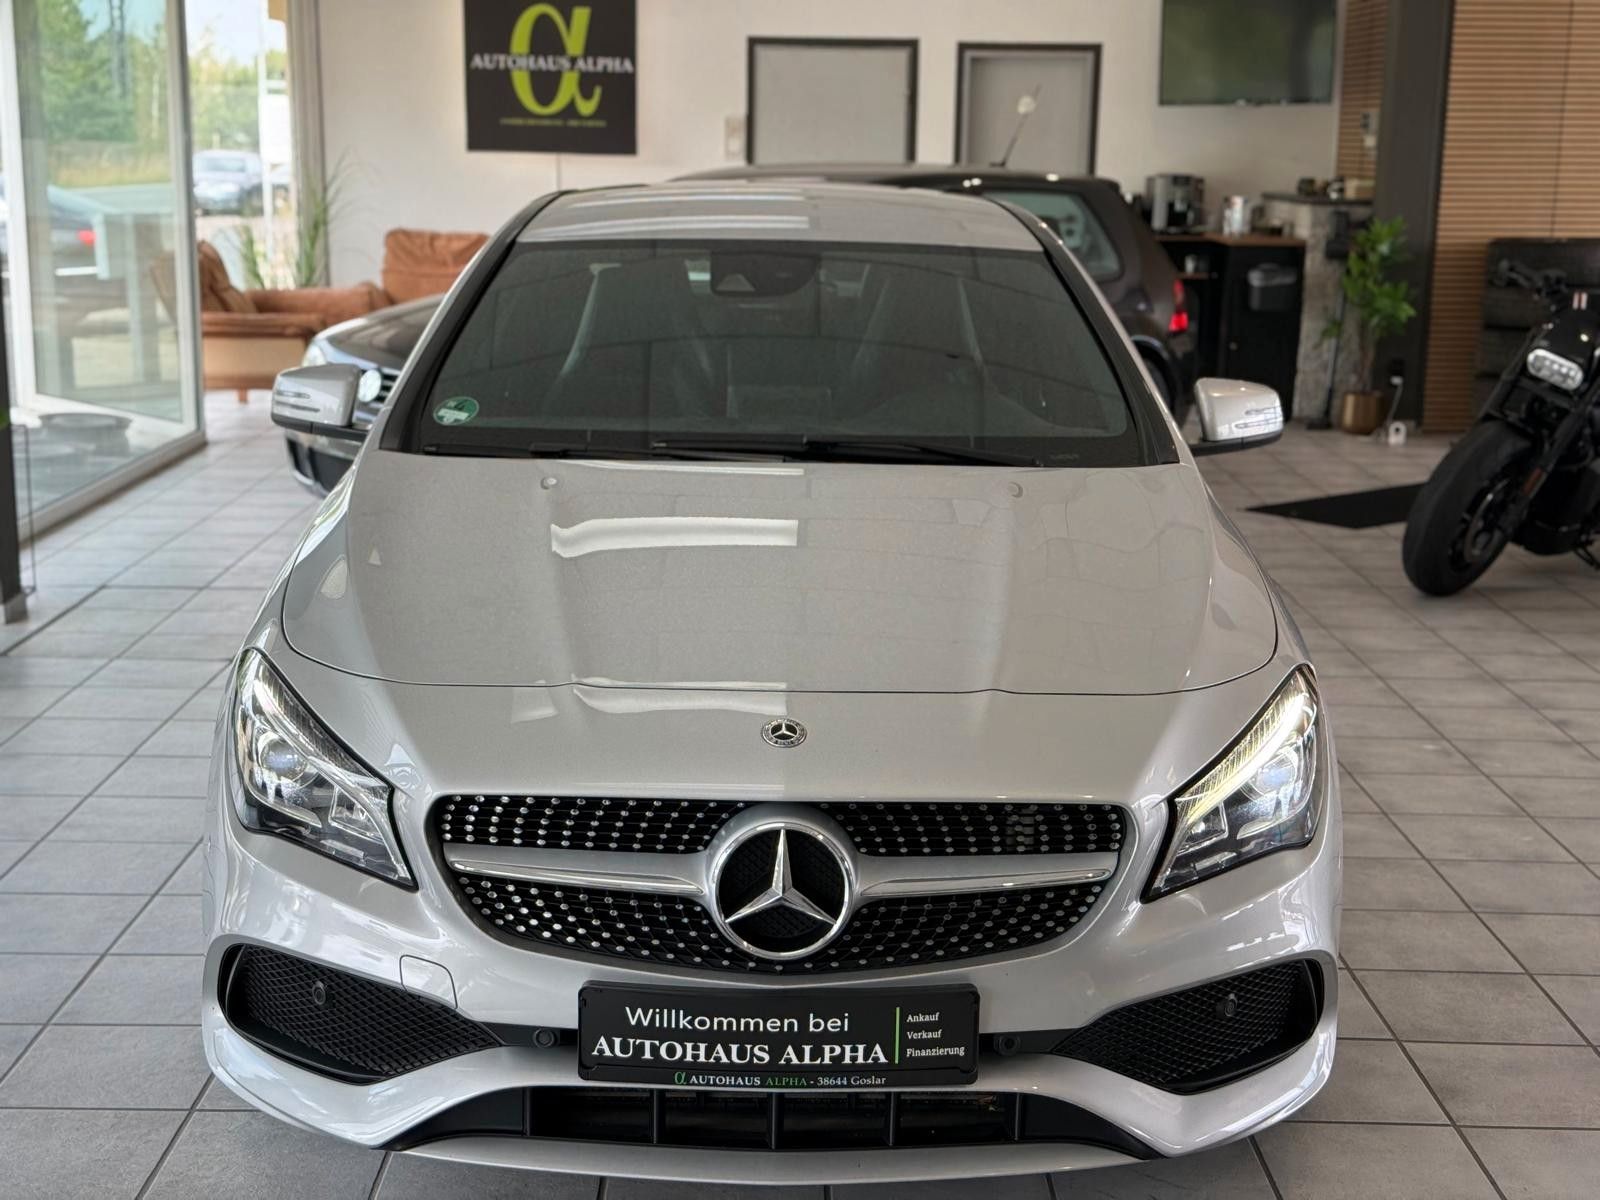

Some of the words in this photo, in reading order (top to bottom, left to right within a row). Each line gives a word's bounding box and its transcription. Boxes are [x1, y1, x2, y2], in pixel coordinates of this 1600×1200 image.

[470, 53, 571, 71] AUTOHAUS
[573, 56, 634, 73] ALPHA
[625, 1006, 798, 1032] Willkommen
[809, 1012, 849, 1032] bei
[906, 1012, 940, 1023] Ankauf
[906, 1029, 942, 1040] Verkauf
[591, 1035, 770, 1065] AUTOHAUS
[778, 1043, 888, 1065] ALPHA
[906, 1046, 965, 1057] Finanzierung
[689, 1076, 761, 1086] AUTOHAUS
[766, 1077, 807, 1086] ALPHA
[817, 1076, 848, 1086] 38644
[851, 1075, 886, 1085] Goslar
